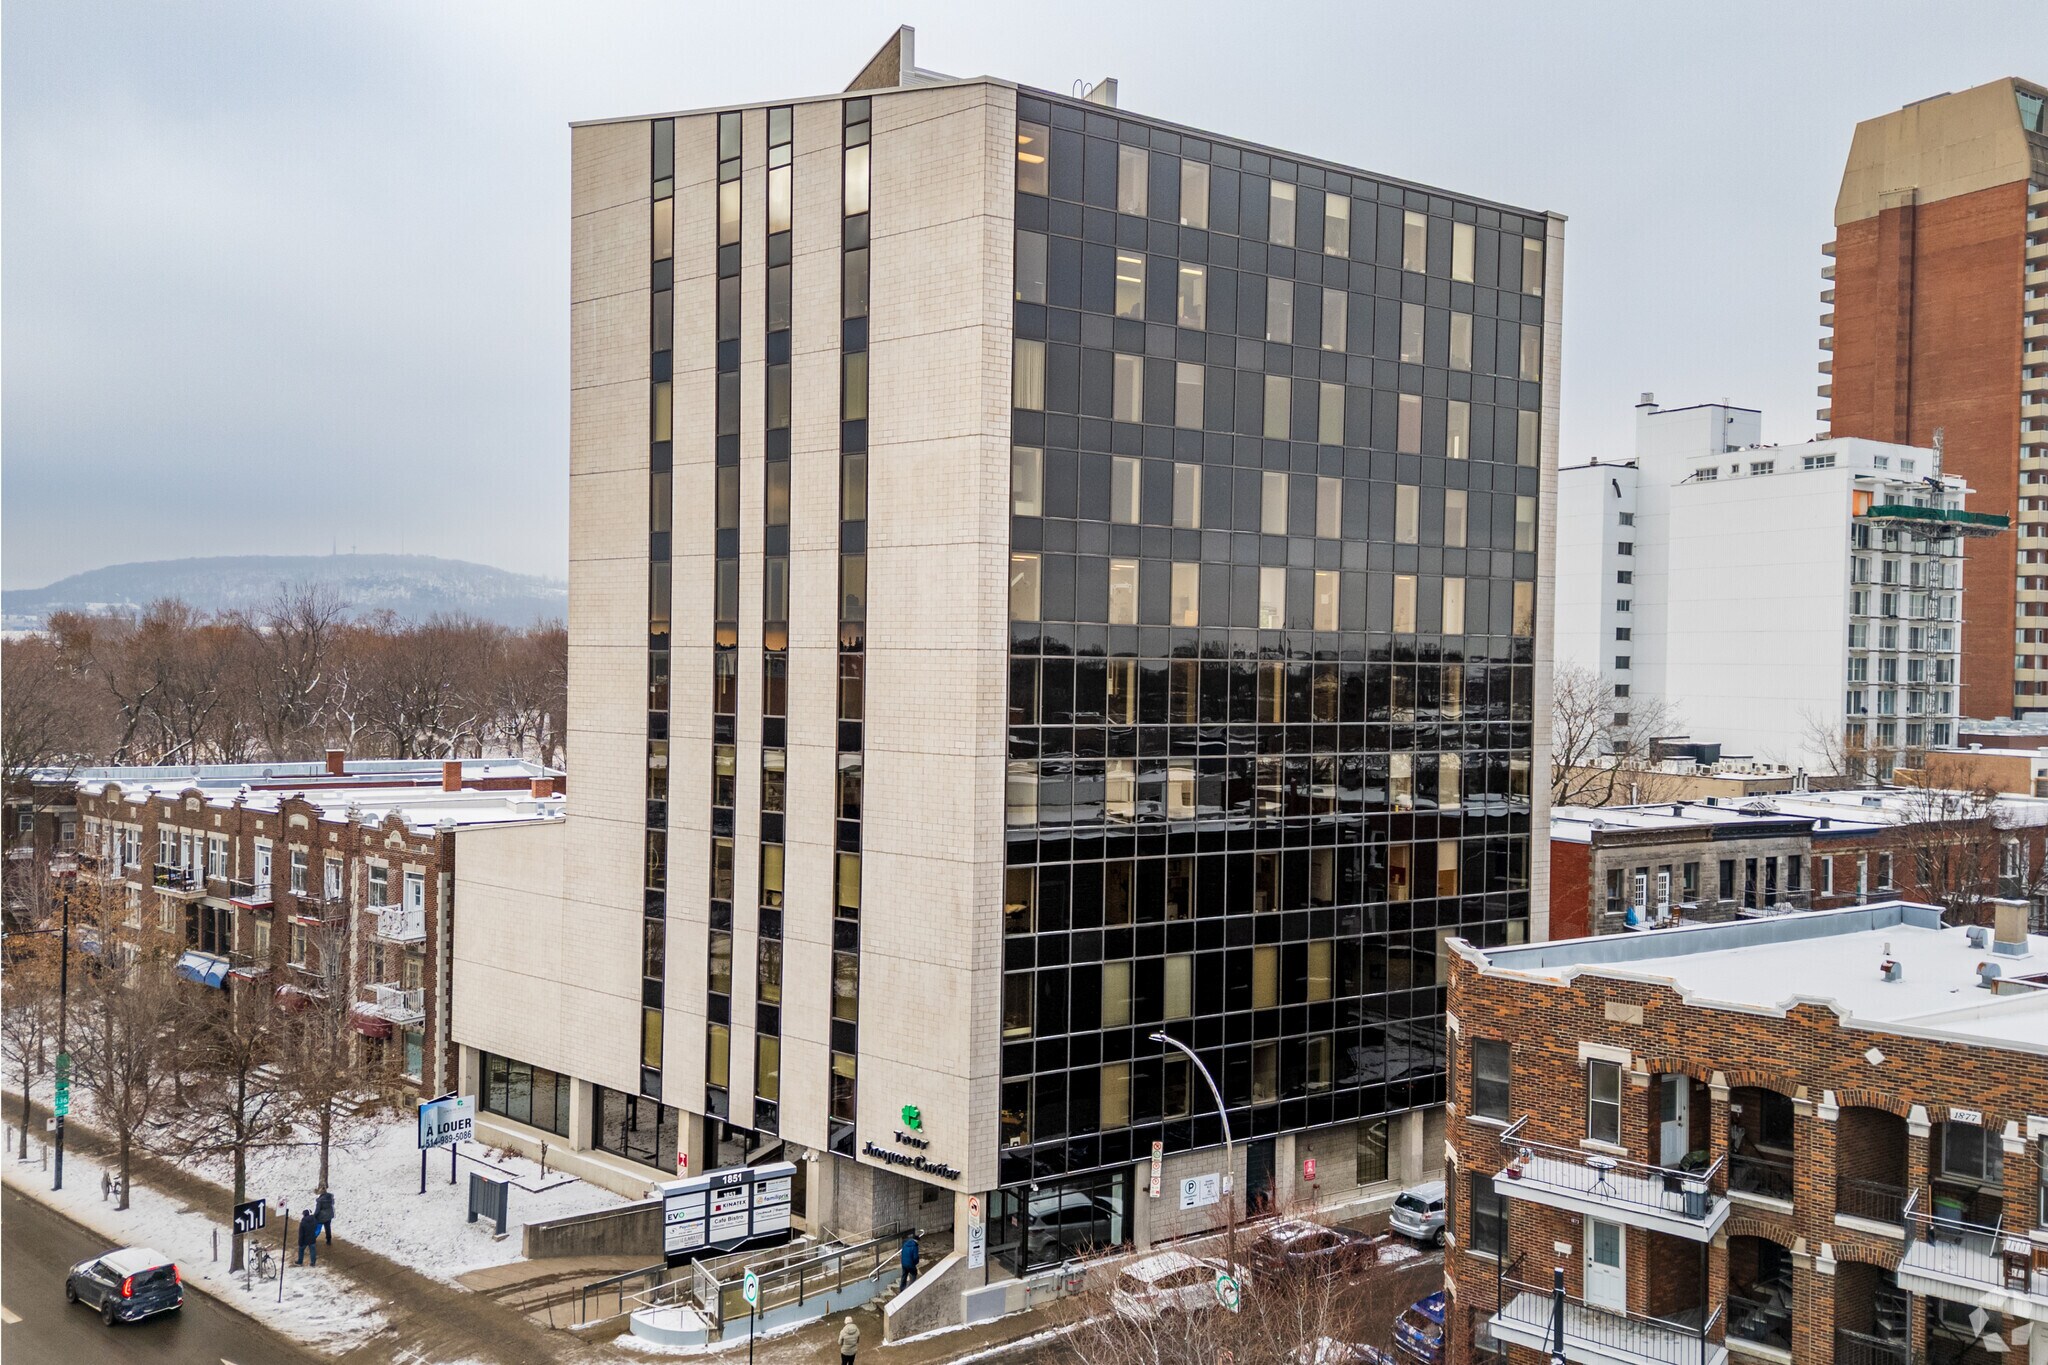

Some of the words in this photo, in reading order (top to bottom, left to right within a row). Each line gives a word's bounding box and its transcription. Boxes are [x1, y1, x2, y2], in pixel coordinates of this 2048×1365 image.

[1954, 1112, 1977, 1121] 1877
[426, 1123, 434, 1137] À
[437, 1117, 472, 1135] LOUER
[425, 1130, 472, 1149] 514-989-5086
[722, 1173, 743, 1184] 1851
[1188, 1182, 1195, 1192] P
[722, 1200, 747, 1208] KINATEX
[667, 1211, 685, 1221] EVO
